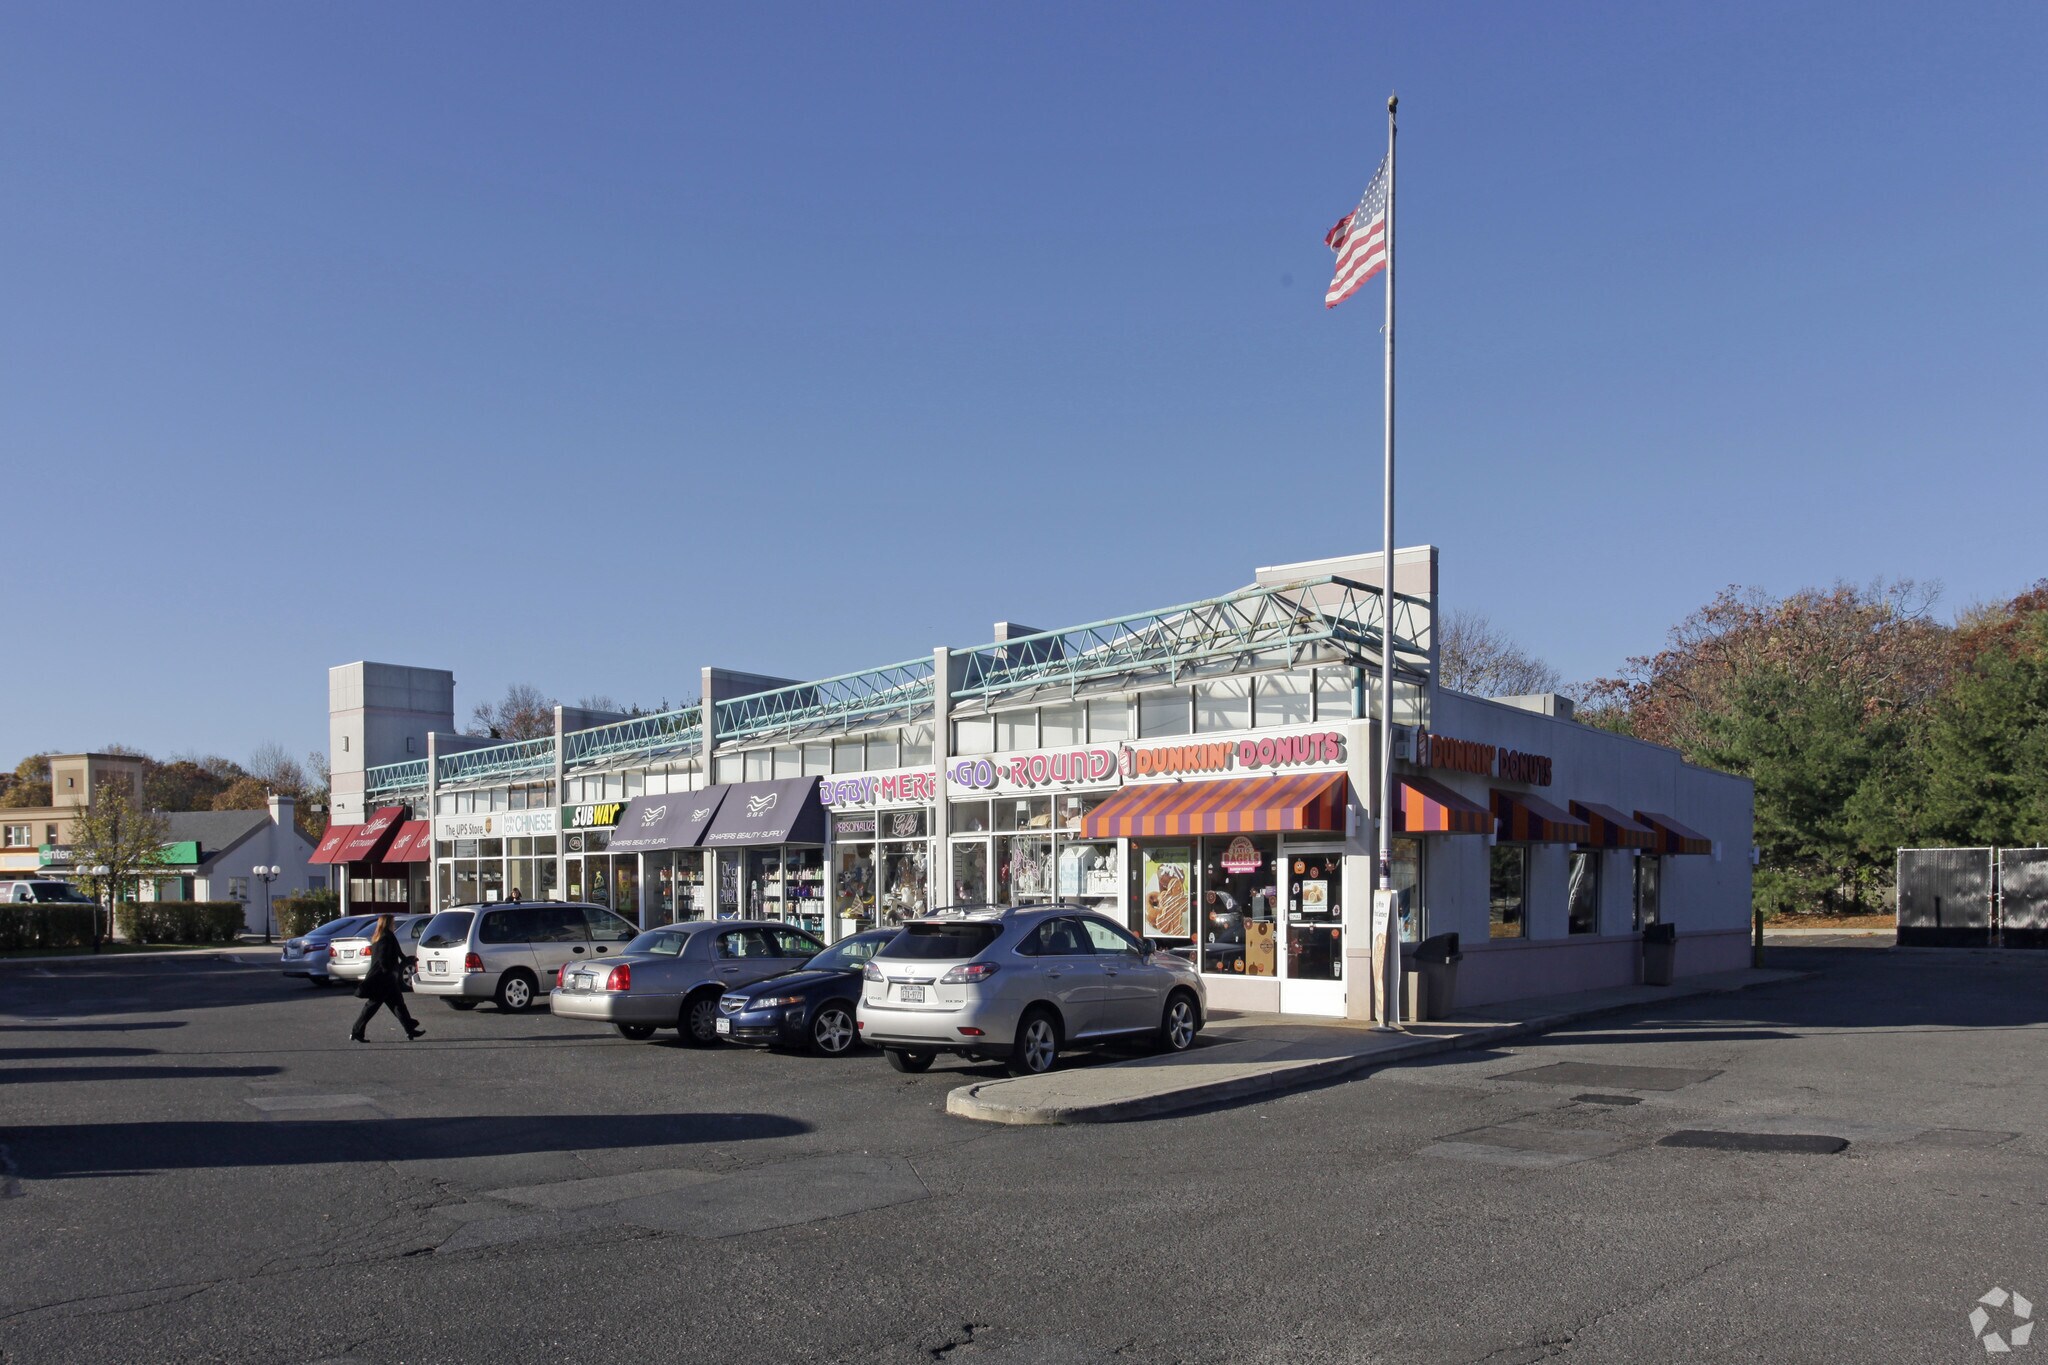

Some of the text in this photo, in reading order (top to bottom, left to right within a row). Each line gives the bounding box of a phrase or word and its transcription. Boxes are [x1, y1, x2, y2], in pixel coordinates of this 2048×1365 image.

[1136, 731, 1339, 774] DUNKIN' DONUTS
[1431, 734, 1553, 786] DUNKIN' DONUTS
[820, 749, 1109, 805] BABY MERR GO ROUND
[515, 813, 552, 832] CHINESE
[572, 802, 620, 827] SUBWAY
[445, 824, 455, 836] The
[456, 823, 467, 835] UPS
[469, 823, 483, 835] Store
[737, 831, 761, 839] BEAUTY
[761, 829, 786, 838] SUPPLY
[632, 838, 651, 846] BEAUTY
